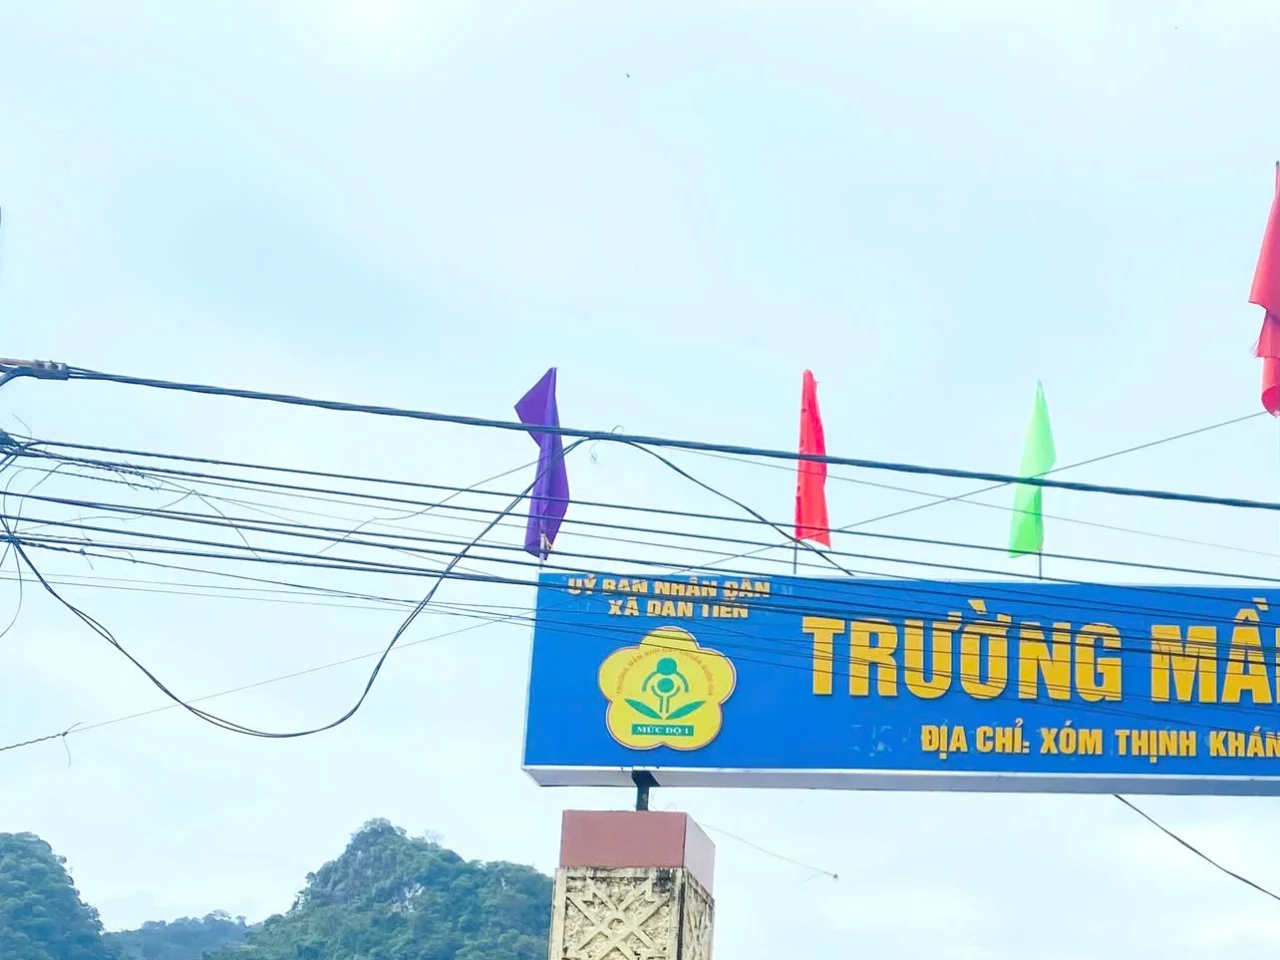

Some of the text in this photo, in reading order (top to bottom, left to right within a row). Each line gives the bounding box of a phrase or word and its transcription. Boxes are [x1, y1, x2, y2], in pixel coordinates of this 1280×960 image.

[602, 578, 648, 596] BAN
[655, 577, 717, 597] NHÂN
[801, 598, 1123, 702] TRƯỜNG
[920, 724, 968, 760] ĐỊA
[1040, 720, 1103, 756] XÓM
[1115, 729, 1197, 763] THỊNH
